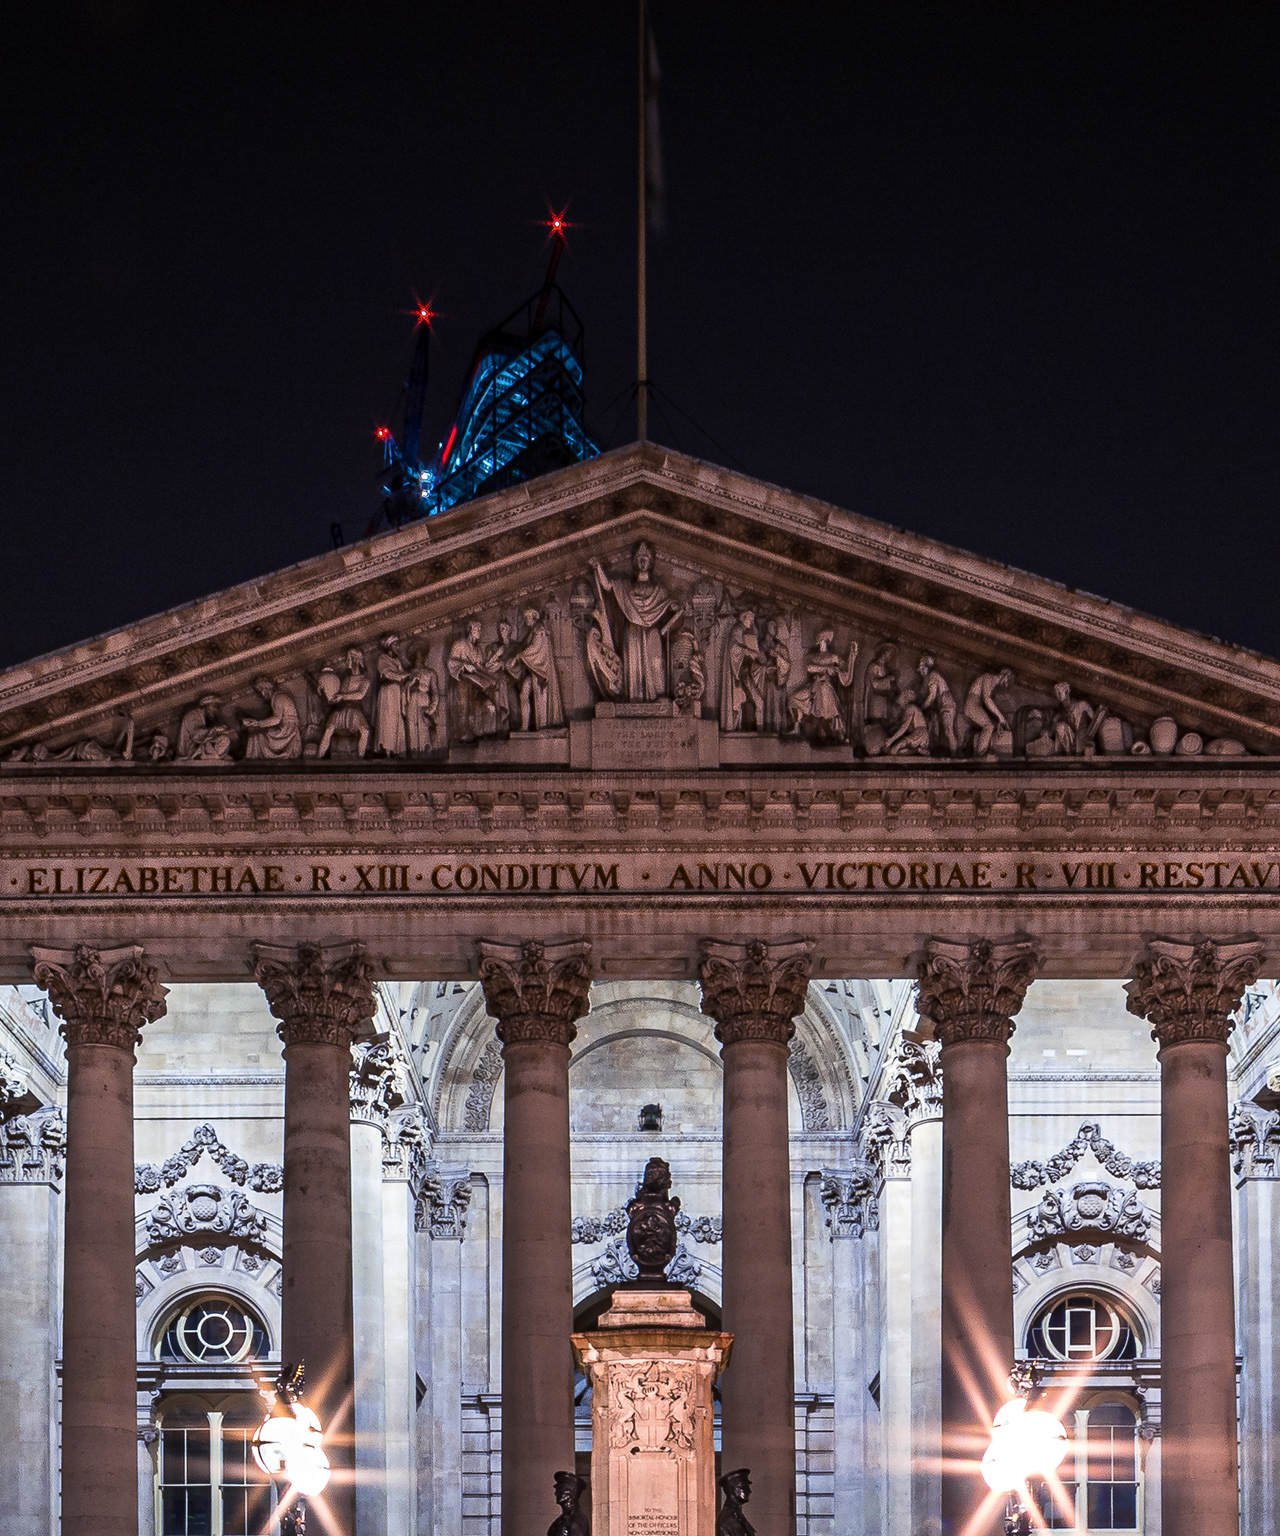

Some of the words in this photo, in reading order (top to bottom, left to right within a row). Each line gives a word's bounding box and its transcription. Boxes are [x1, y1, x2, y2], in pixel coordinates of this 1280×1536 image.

[25, 864, 286, 895] ELIZABETHAE
[310, 865, 332, 892] R
[354, 864, 410, 892] XIII
[430, 863, 620, 892] CONDITVM
[668, 862, 773, 891] ANNO
[797, 862, 992, 890] VICTORIAE
[1019, 862, 1039, 890] R
[1060, 862, 1117, 890] VIII
